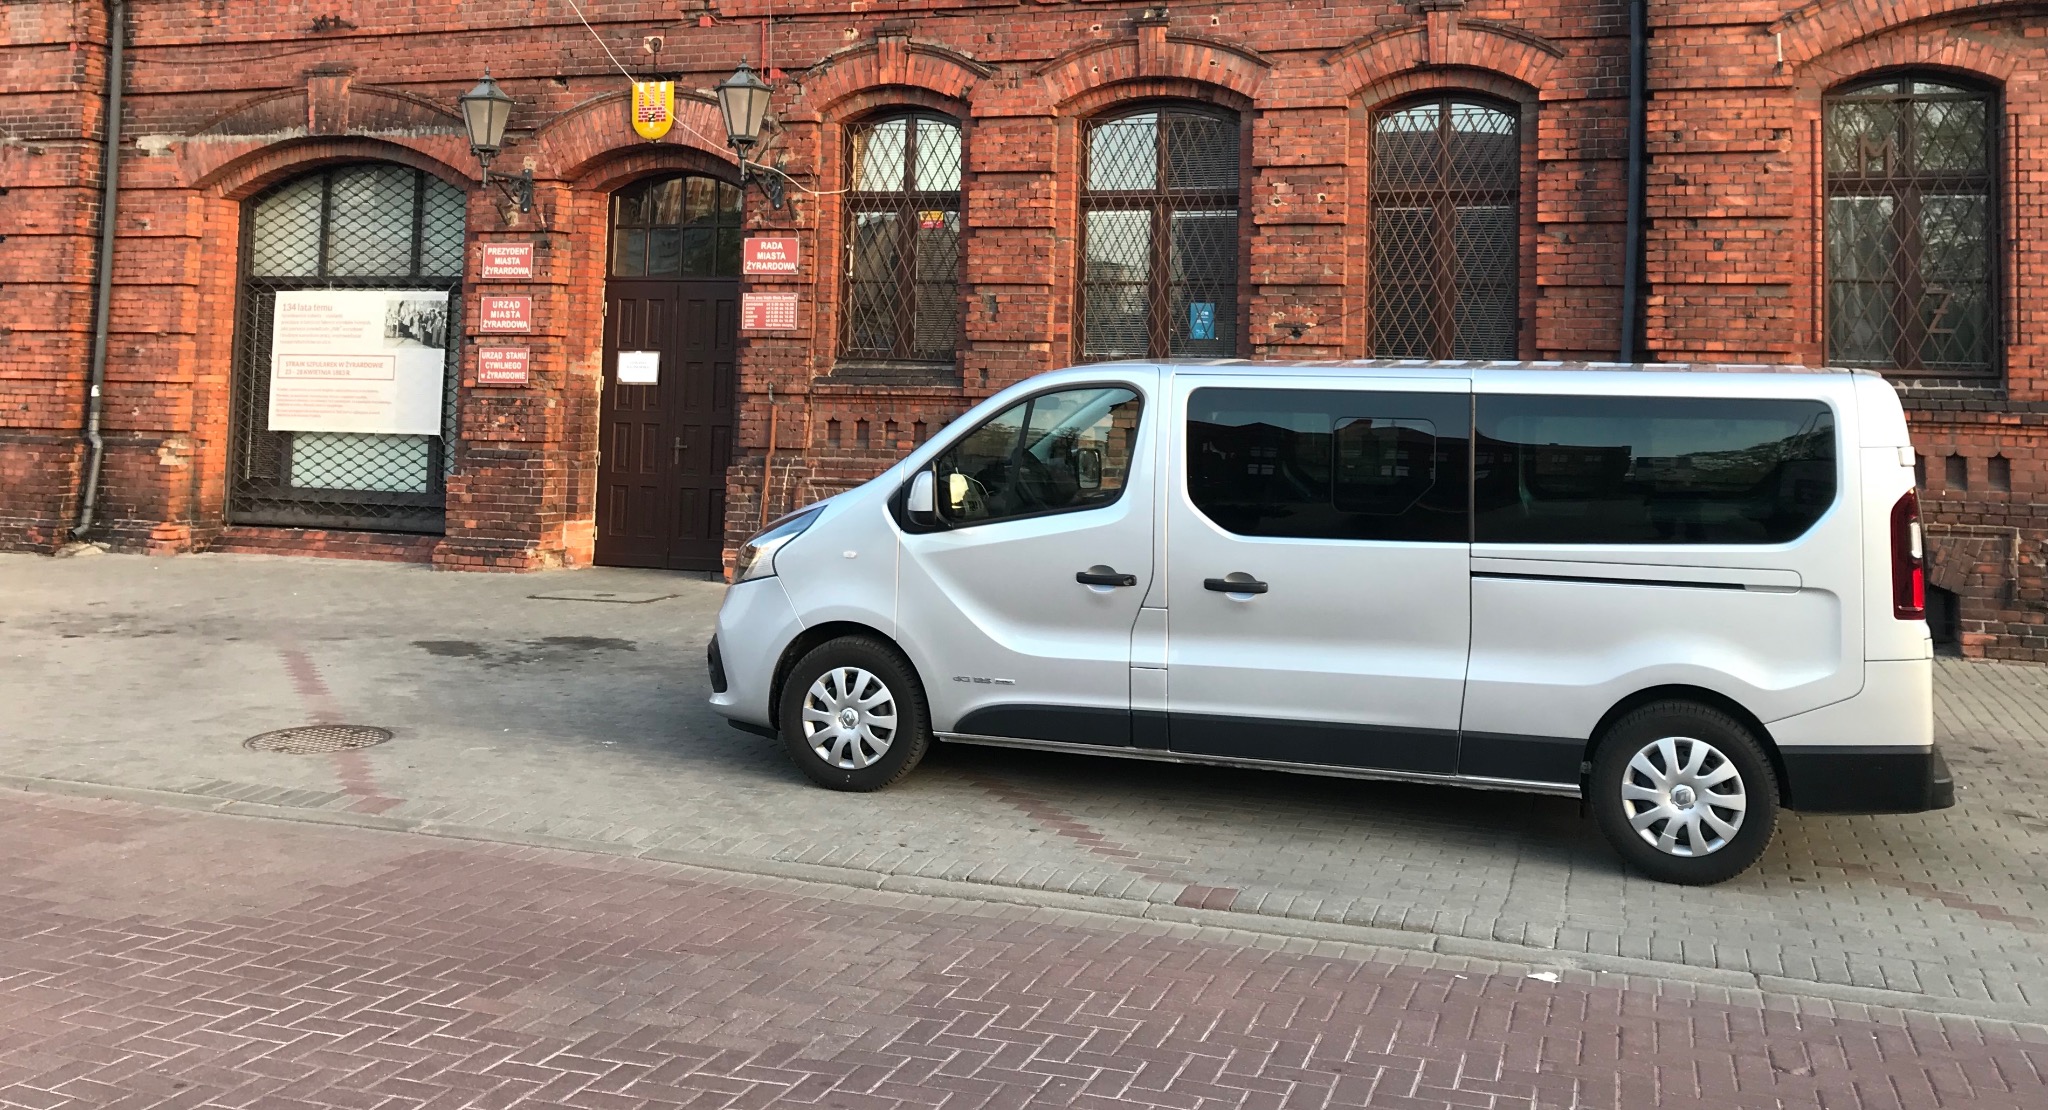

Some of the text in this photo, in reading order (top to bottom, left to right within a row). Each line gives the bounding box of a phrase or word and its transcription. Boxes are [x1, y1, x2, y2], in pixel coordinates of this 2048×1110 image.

[760, 241, 783, 250] RADA
[487, 247, 529, 255] PREZYDENT
[756, 252, 786, 260] MIASTA
[494, 257, 521, 265] MIASTA
[484, 266, 530, 275] ŻYRARDOWA
[746, 261, 796, 271] ŻYRARDOWA
[282, 303, 333, 312] 134 lata temu
[492, 301, 521, 310] URZĄD
[490, 310, 521, 319] MIASTA
[482, 319, 528, 328] ŻYRARDOWA
[481, 352, 527, 361] URZĄD STANU
[485, 362, 522, 370] CYWILNEGO
[486, 370, 526, 379] ŻYRARDOWIE
